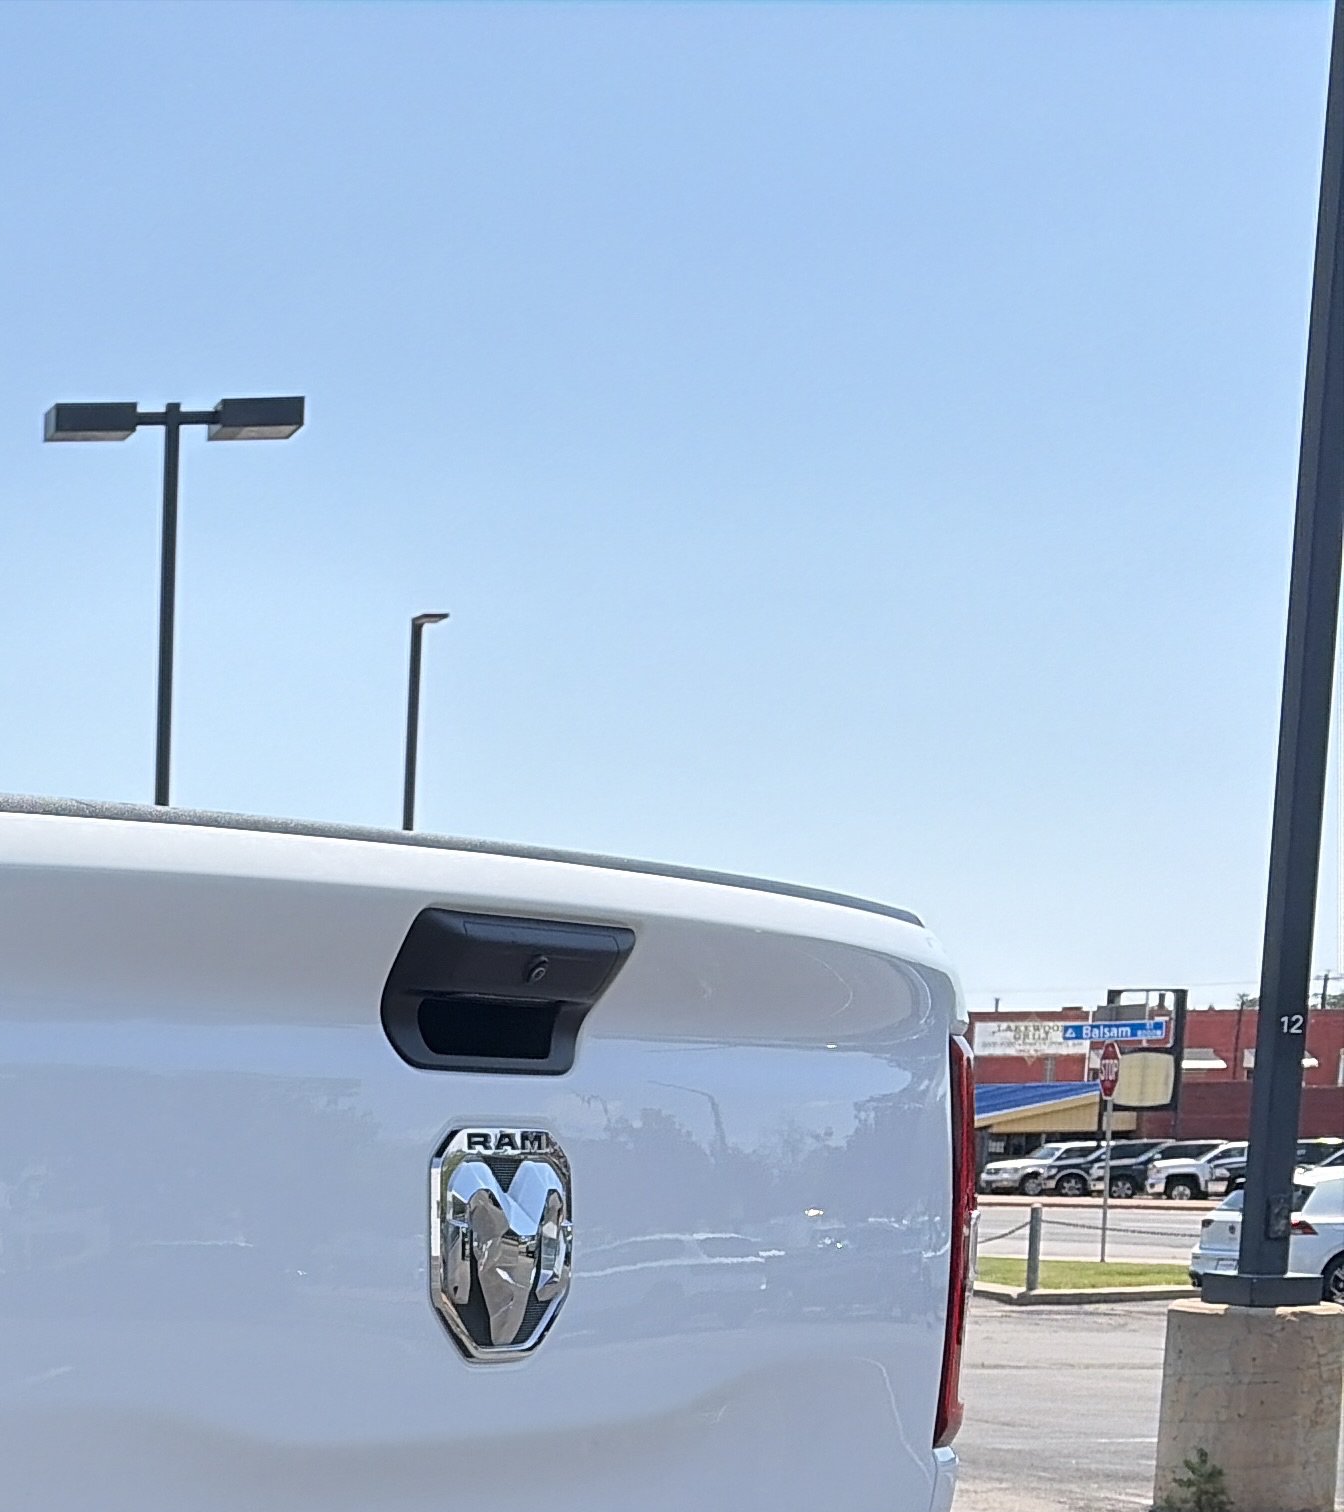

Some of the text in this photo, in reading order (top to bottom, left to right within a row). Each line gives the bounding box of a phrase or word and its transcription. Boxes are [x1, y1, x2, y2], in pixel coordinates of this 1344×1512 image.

[997, 1023, 1062, 1033] LAKEWOO
[1082, 1025, 1131, 1039] Balsam
[1280, 1014, 1304, 1034] 12
[1099, 1059, 1119, 1081] STOP
[466, 1131, 544, 1151] RAM
